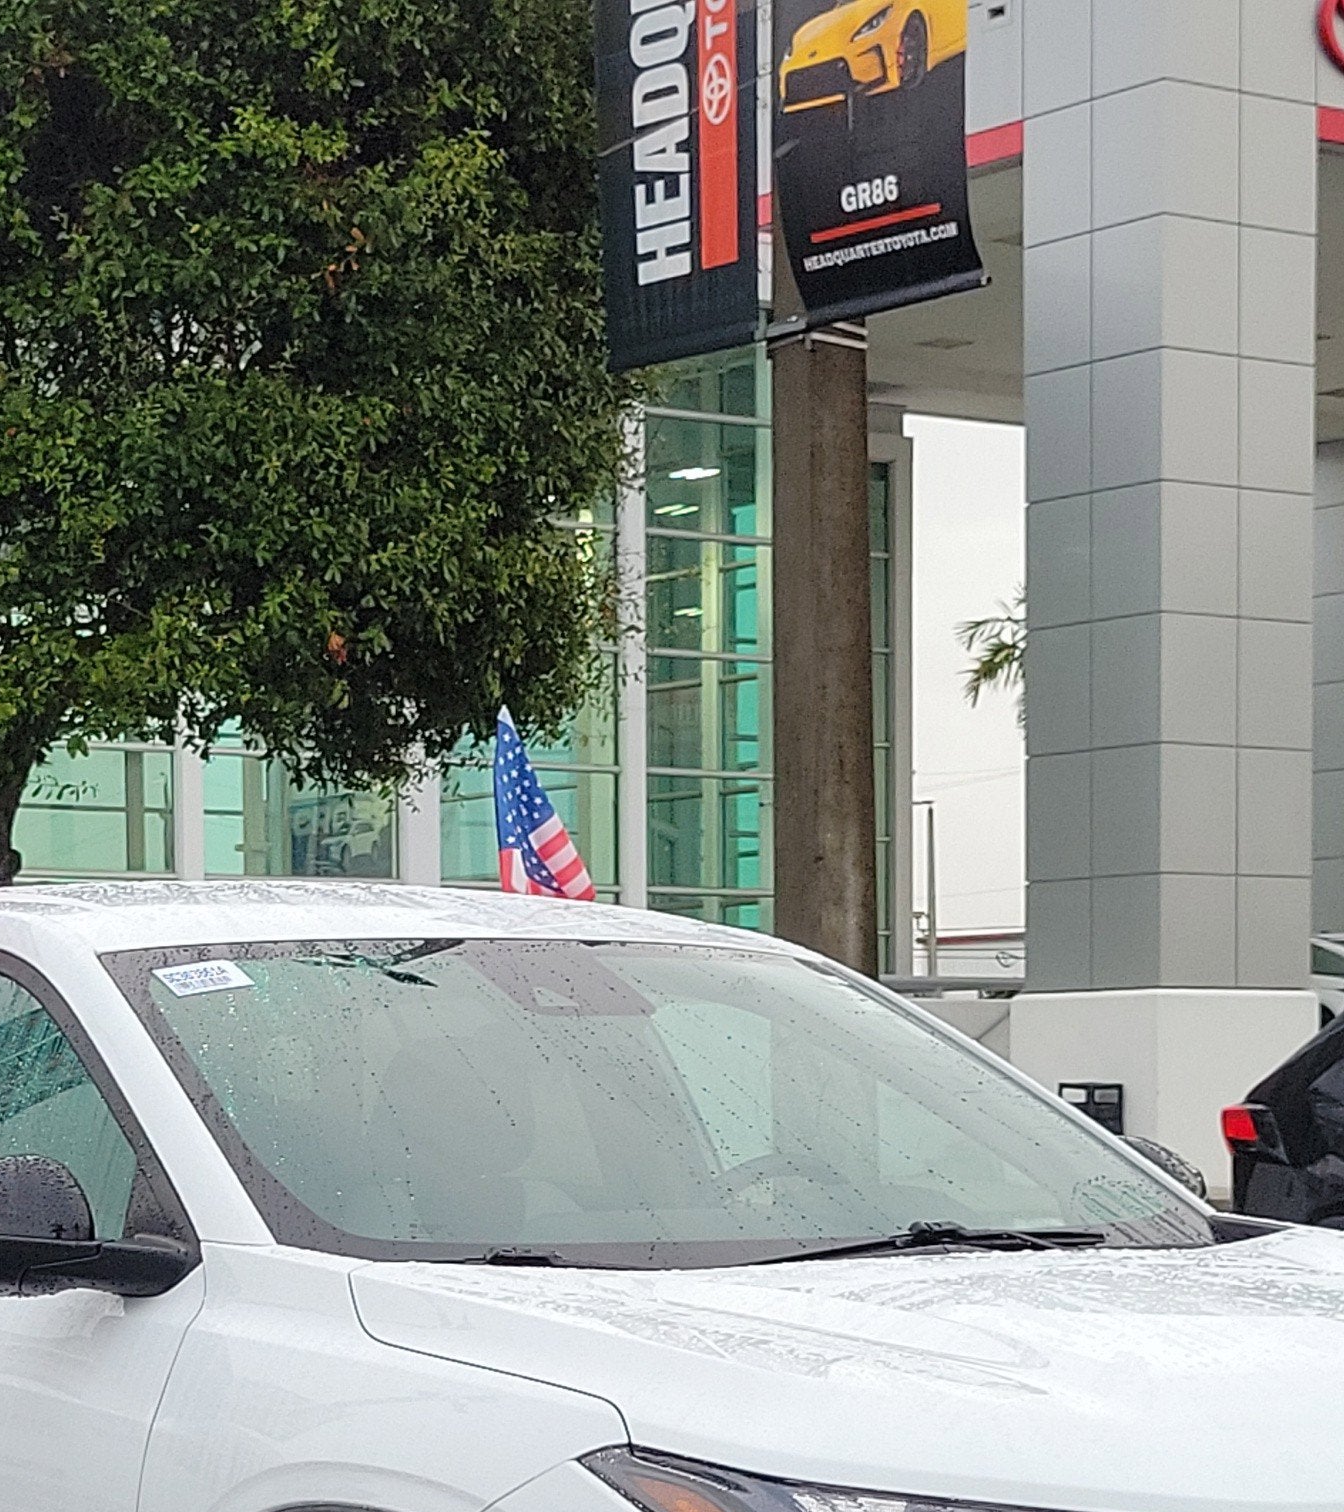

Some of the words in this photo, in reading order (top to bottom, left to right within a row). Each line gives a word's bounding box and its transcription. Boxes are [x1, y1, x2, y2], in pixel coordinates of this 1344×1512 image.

[629, 0, 693, 287] HEADQ
[840, 174, 899, 213] GR86
[802, 221, 959, 272] HEADQUARTERTOYOTA.COM
